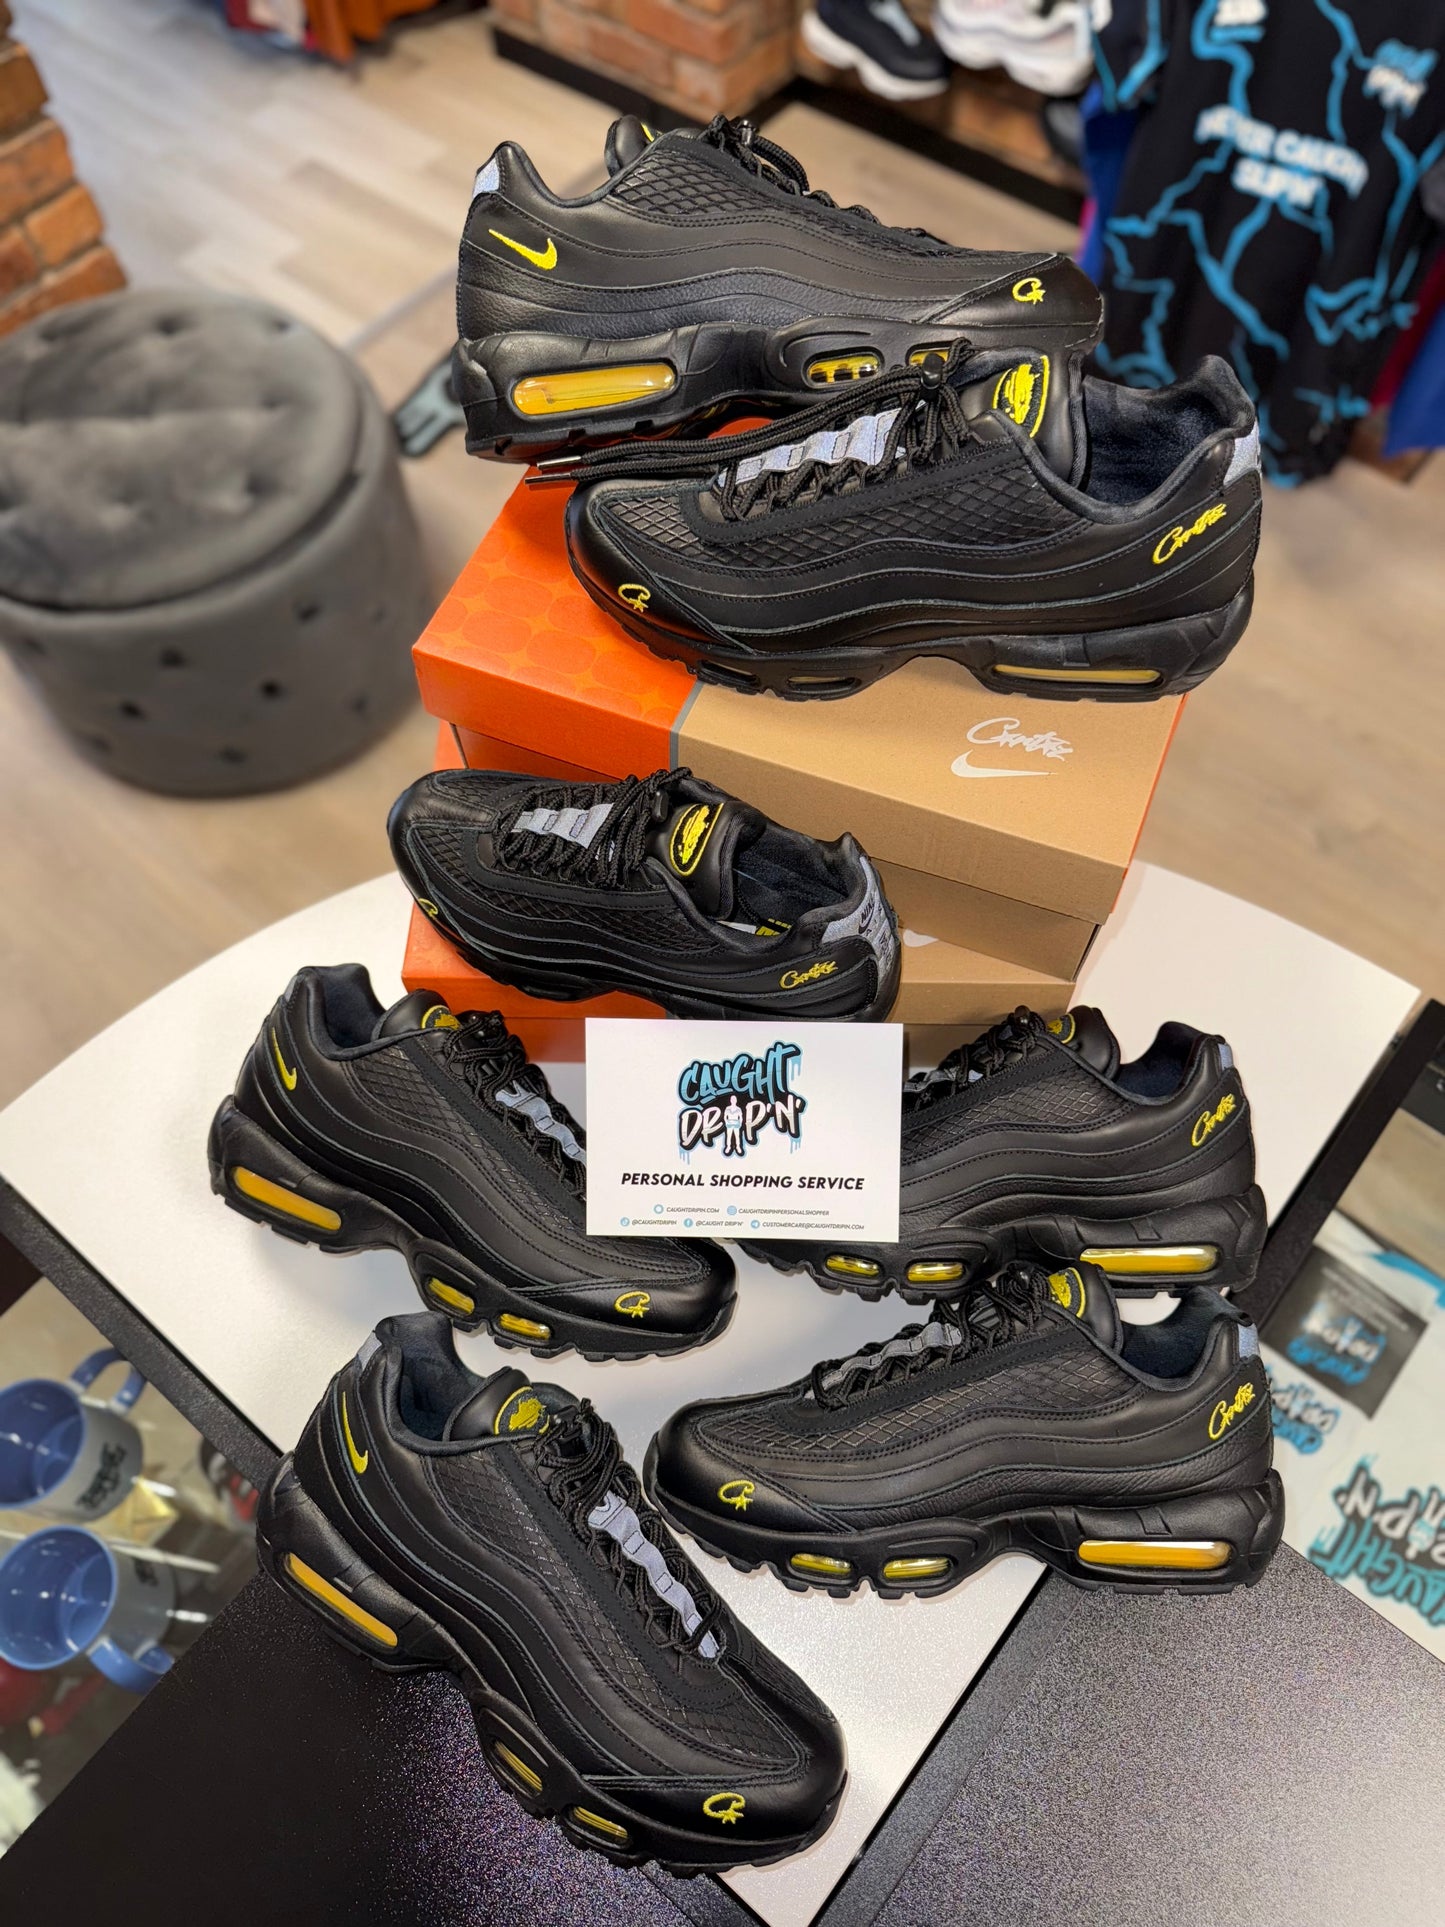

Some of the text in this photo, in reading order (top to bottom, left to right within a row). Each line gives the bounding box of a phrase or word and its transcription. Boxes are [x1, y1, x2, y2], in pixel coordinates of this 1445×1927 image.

[678, 1040, 801, 1105] CAUGHT
[621, 1172, 865, 1190] PERSONAL SHOPPING SERVICE
[666, 1206, 720, 1214] CAUGHTDRIPIN.COM
[762, 1221, 865, 1230] CUSTOMERCARE@CAUGHTDRIPIN.COM
[1308, 1517, 1445, 1627] AUGHT
